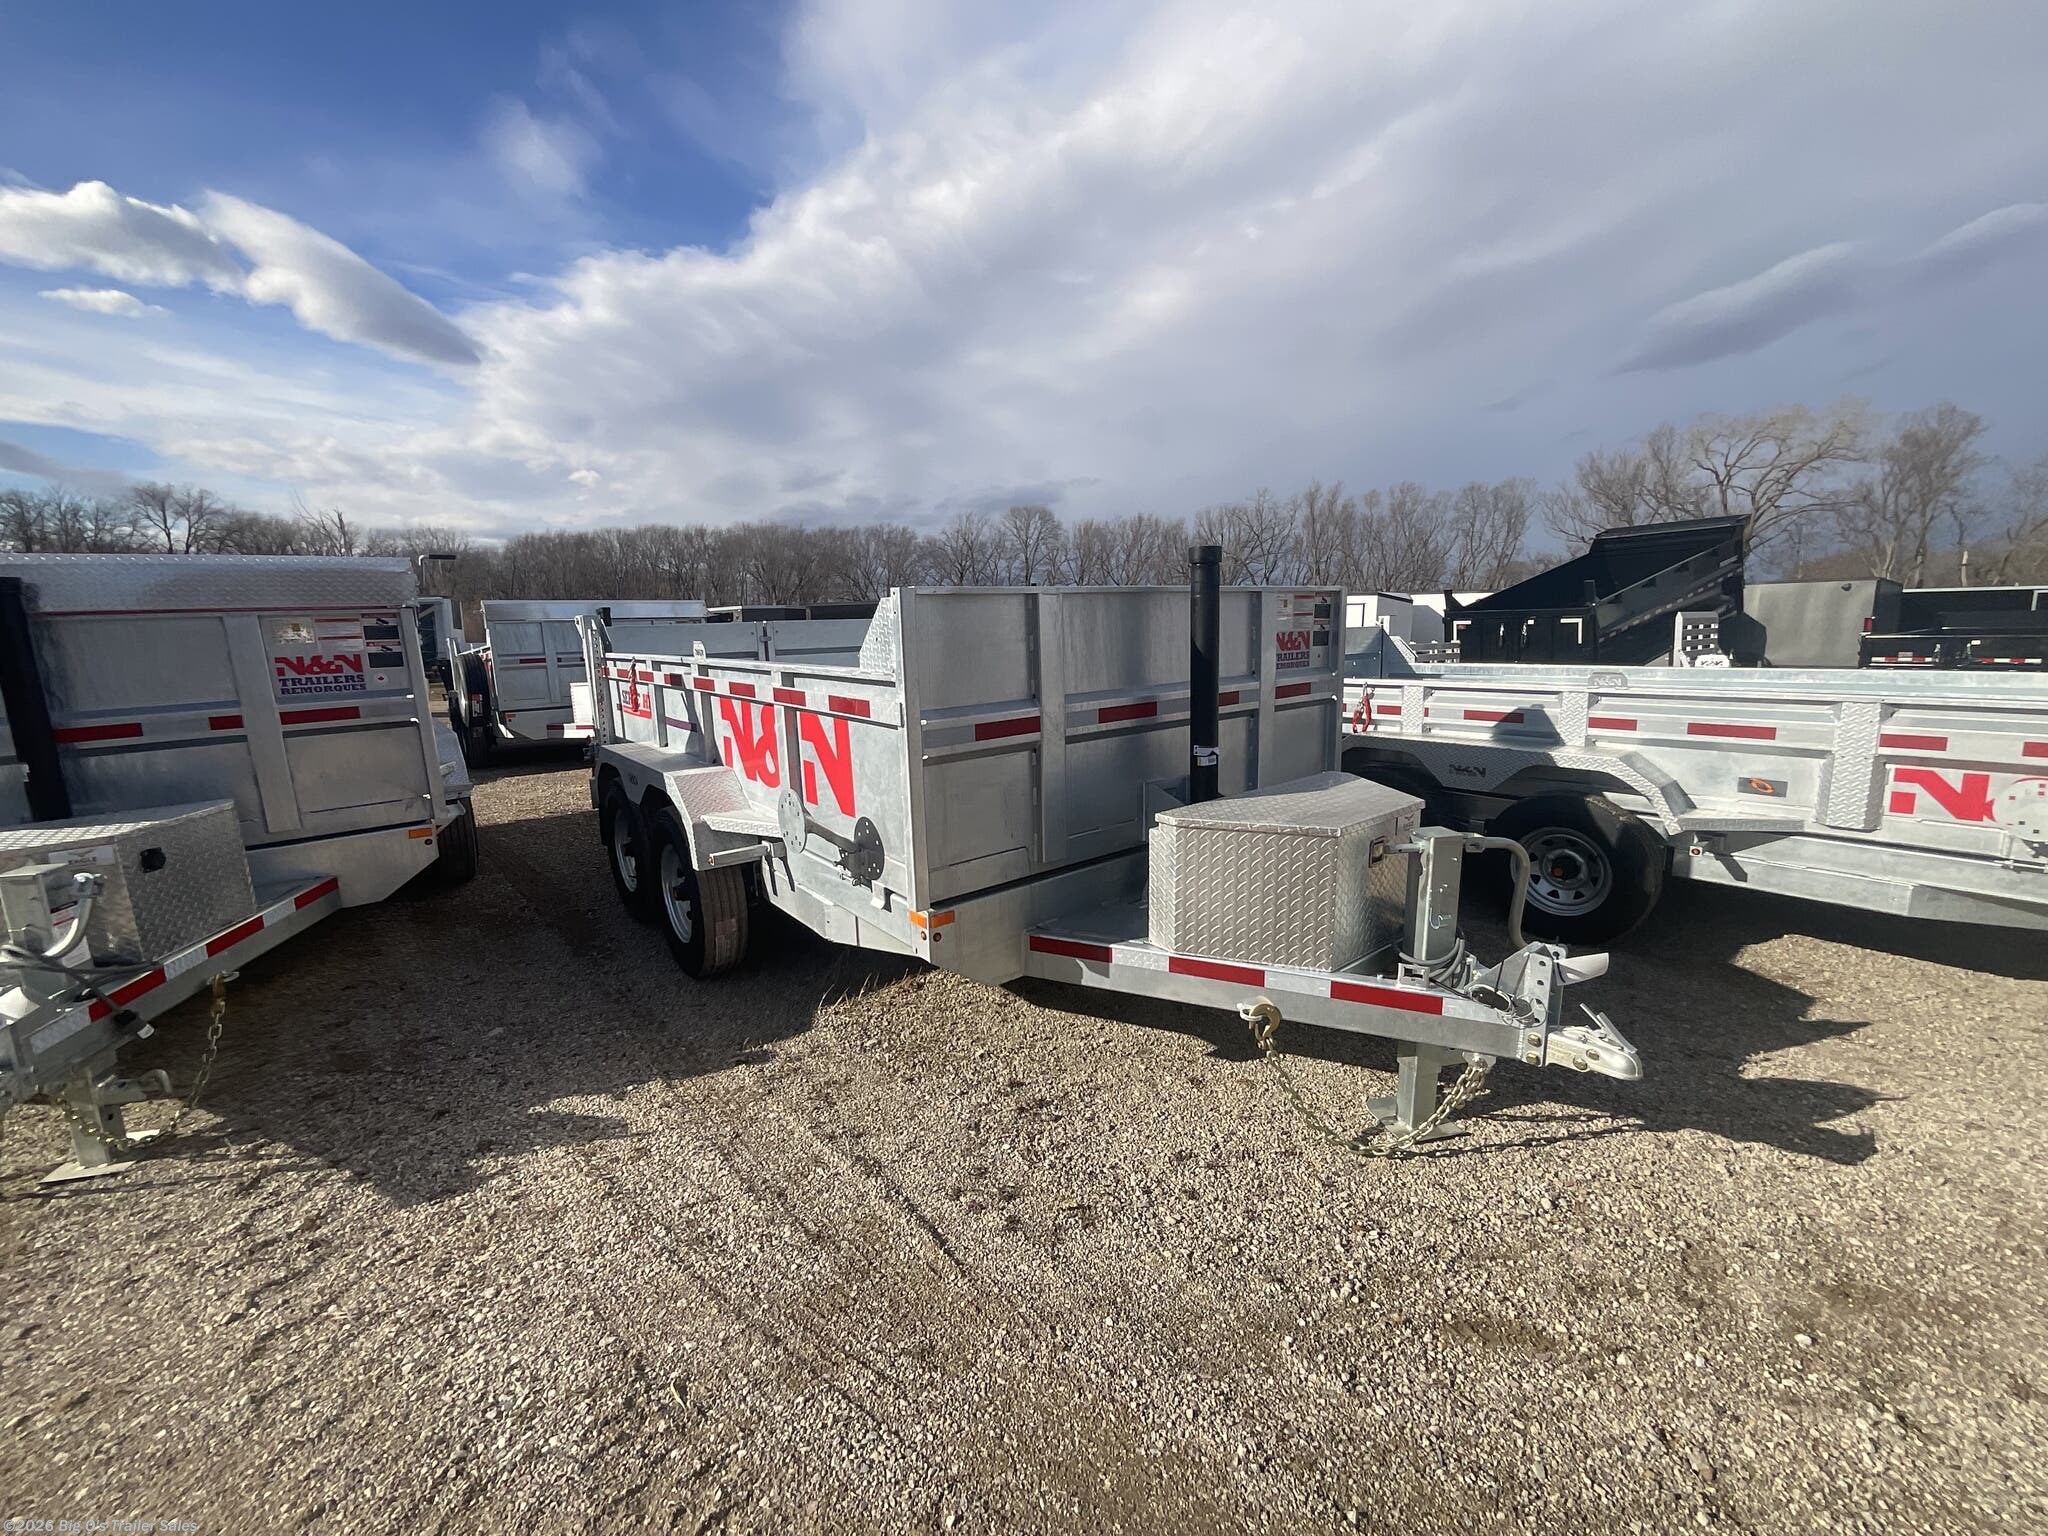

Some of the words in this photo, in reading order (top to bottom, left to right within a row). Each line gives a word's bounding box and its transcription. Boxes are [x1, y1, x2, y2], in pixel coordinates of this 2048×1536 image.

[274, 653, 364, 676] N&N
[279, 674, 365, 687] TRAILERS
[280, 683, 367, 695] REMORQUES
